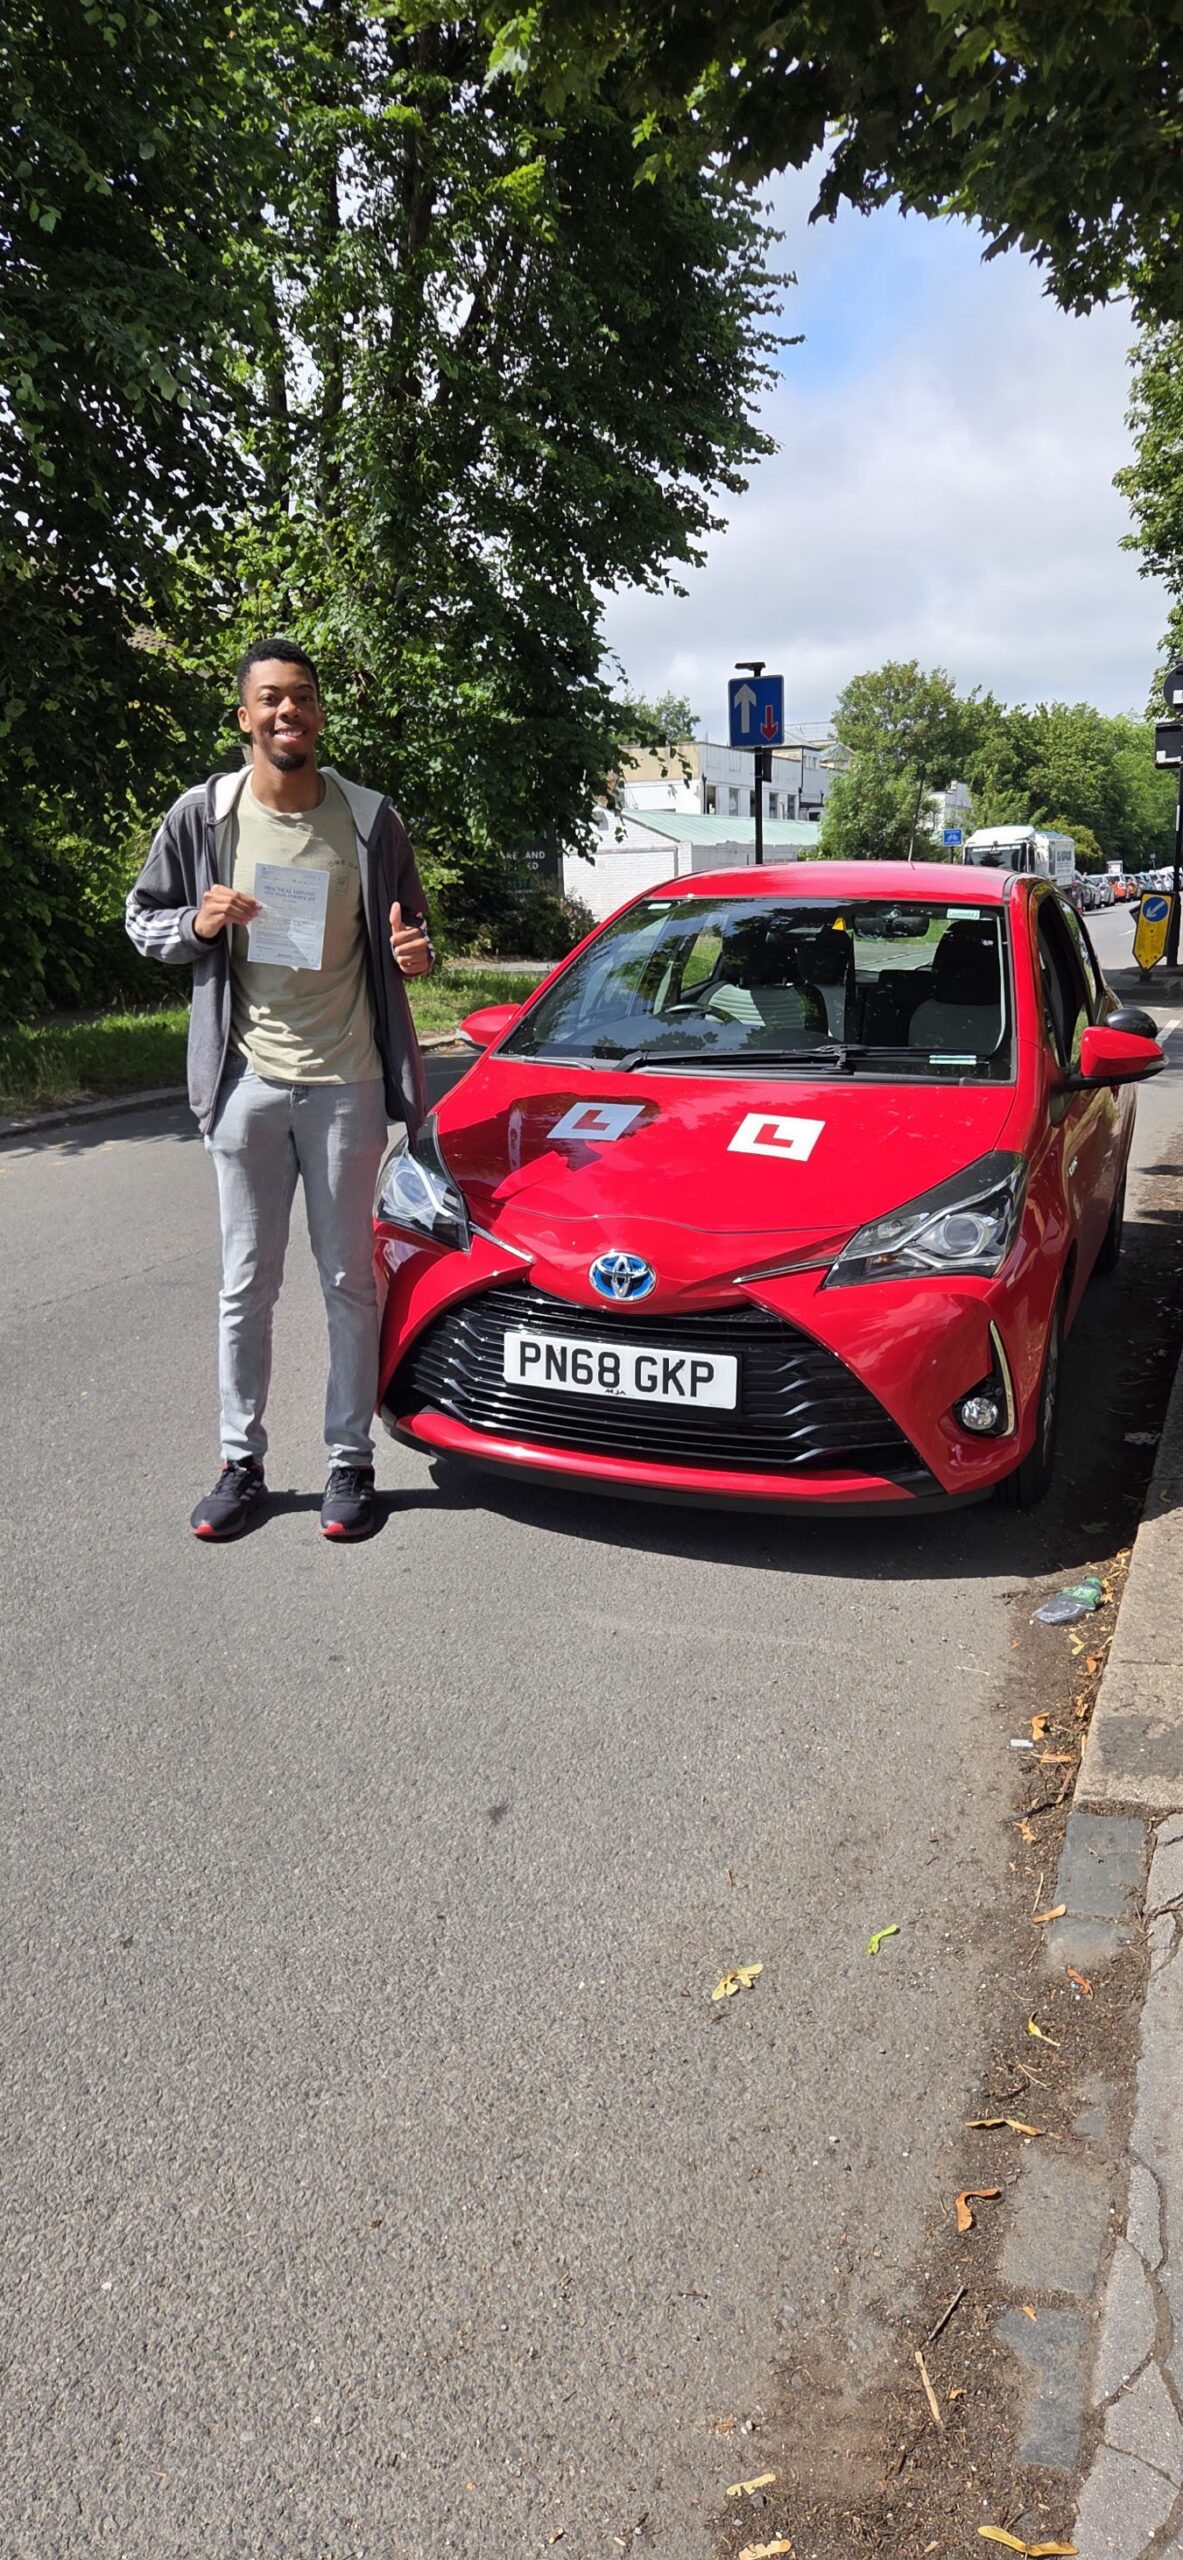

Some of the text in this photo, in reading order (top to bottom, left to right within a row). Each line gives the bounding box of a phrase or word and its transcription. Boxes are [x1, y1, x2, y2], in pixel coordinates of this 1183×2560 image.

[525, 850, 546, 859] AND
[571, 1109, 611, 1131] L
[753, 1123, 794, 1148] L
[519, 1340, 715, 1398] PN68 GKP
